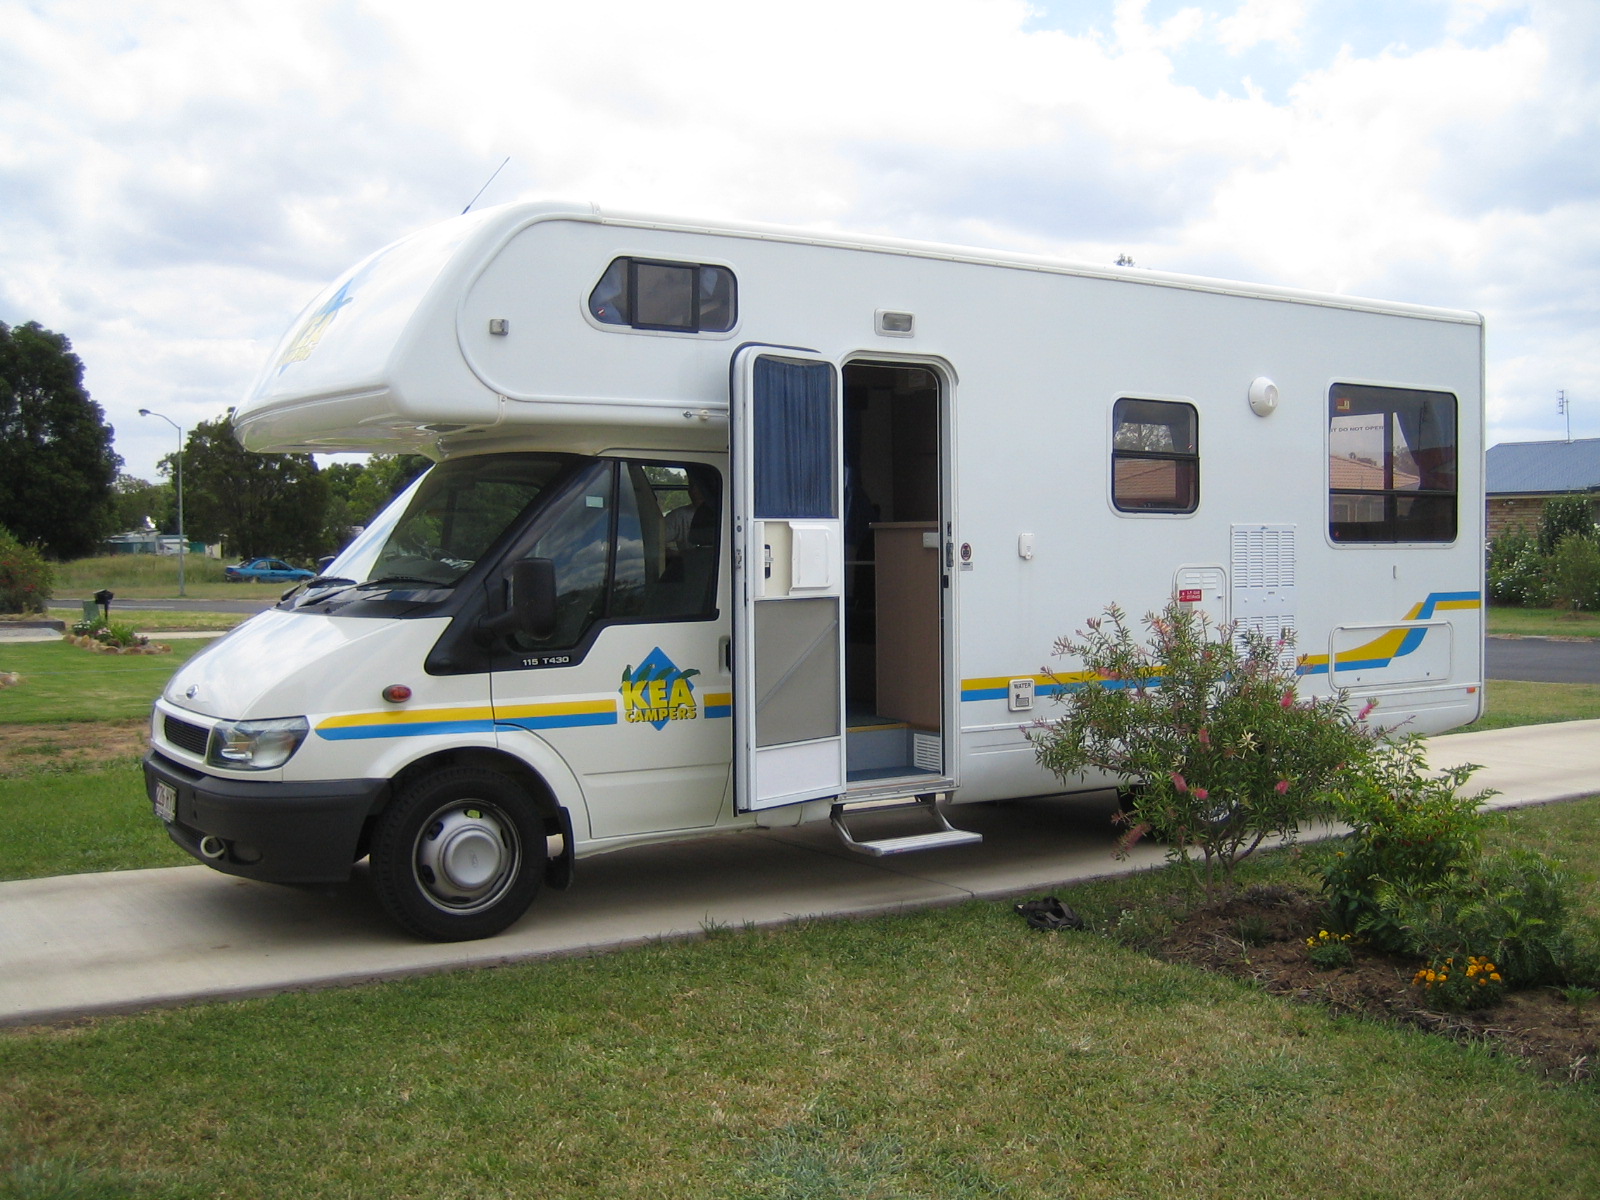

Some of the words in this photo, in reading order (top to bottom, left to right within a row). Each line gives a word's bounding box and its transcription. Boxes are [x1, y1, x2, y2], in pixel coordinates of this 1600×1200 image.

[522, 658, 539, 666] 115
[542, 656, 570, 665] T430
[622, 678, 696, 710] KEA
[625, 707, 697, 723] CAMPERS
